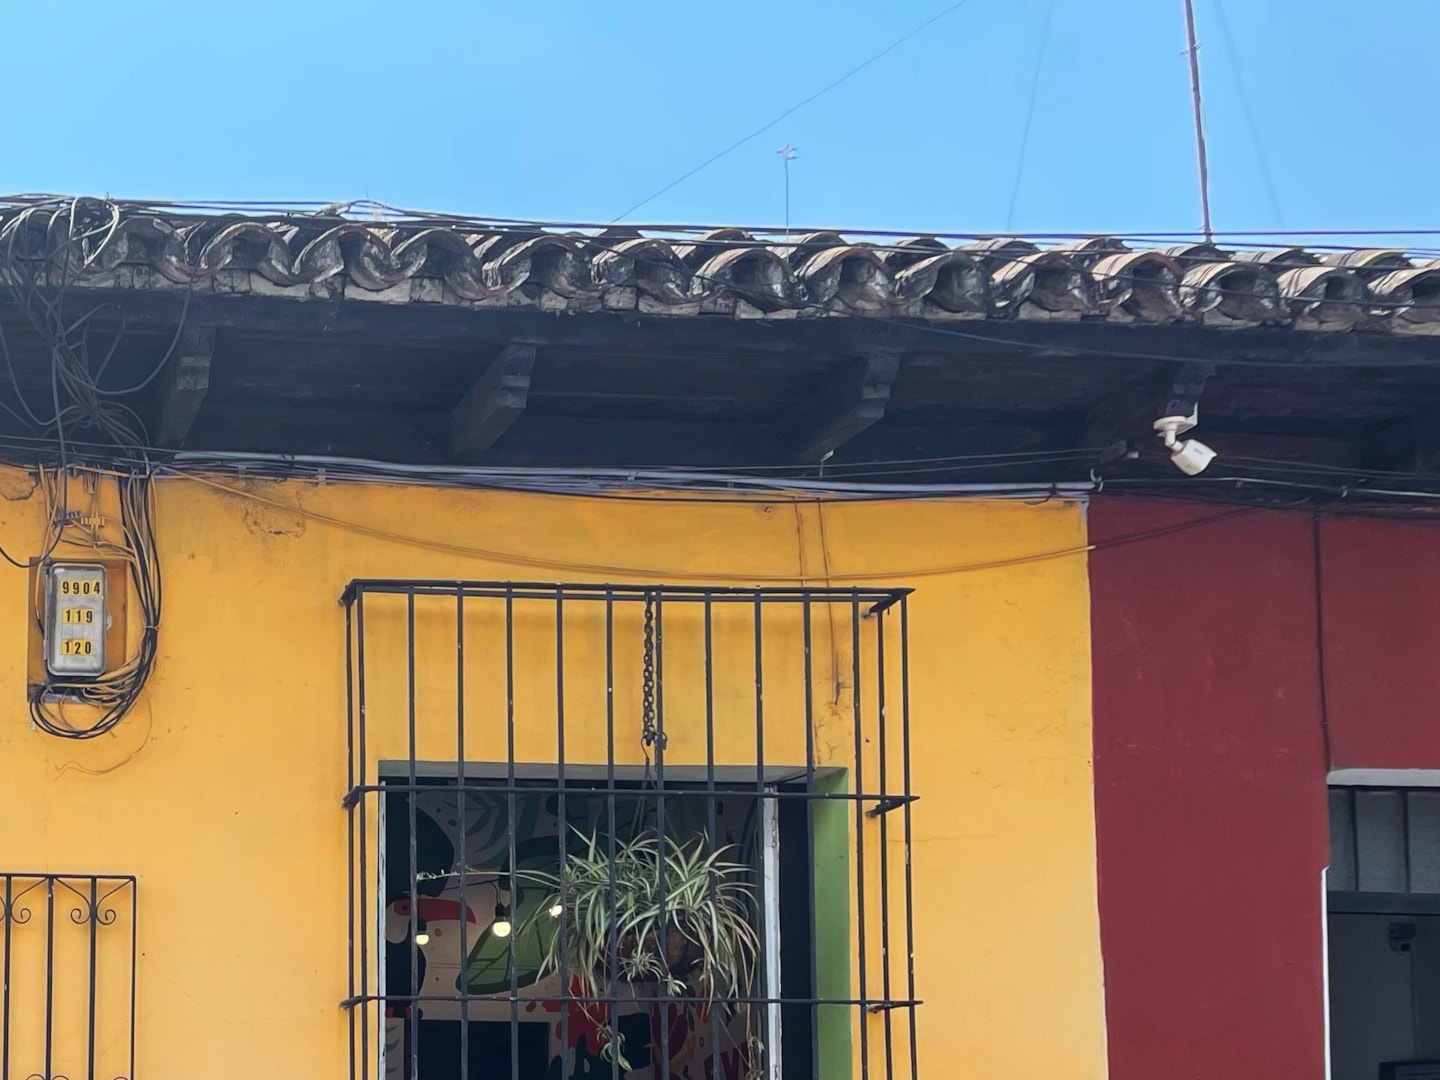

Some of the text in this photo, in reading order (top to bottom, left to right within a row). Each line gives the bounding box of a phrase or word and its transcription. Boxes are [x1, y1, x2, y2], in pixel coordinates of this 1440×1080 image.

[62, 581, 101, 595] 9904
[65, 610, 93, 624] 119
[64, 641, 92, 655] 120
